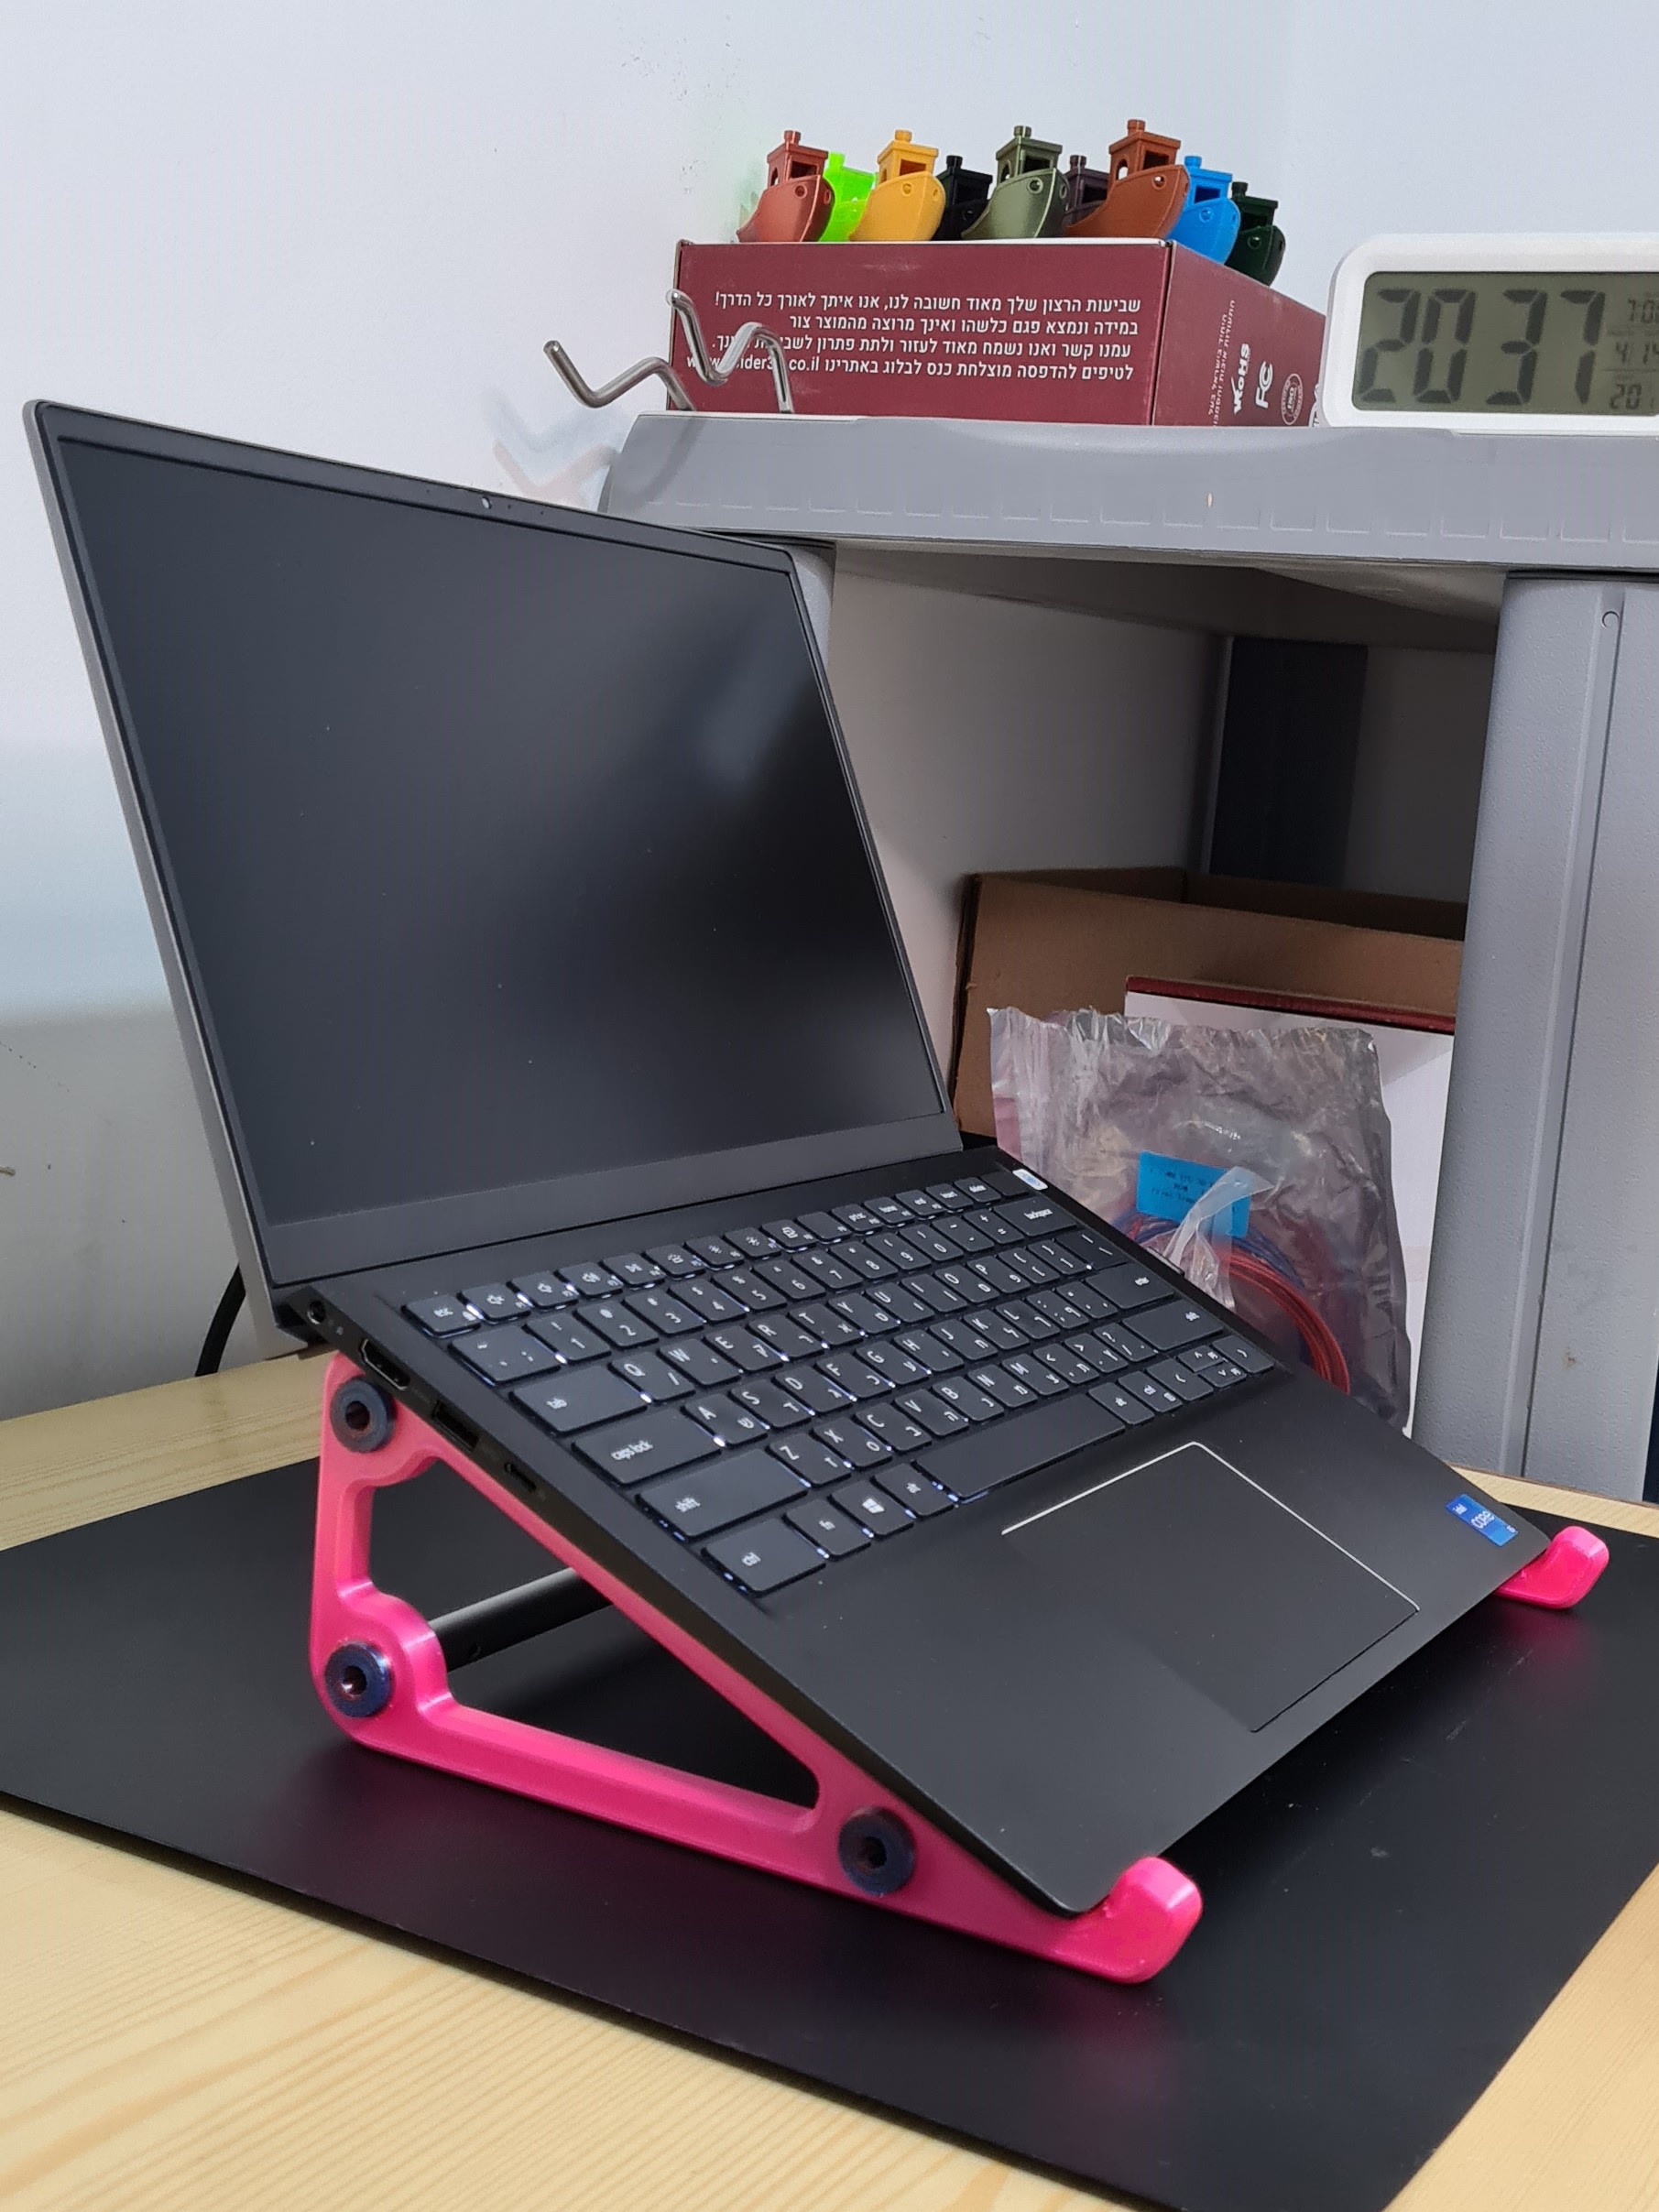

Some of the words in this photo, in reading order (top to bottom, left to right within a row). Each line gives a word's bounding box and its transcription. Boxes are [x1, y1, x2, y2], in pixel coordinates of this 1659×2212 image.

[715, 290, 752, 310] הדרך!
[756, 290, 772, 307] כל
[778, 291, 816, 311] לאורך
[821, 294, 854, 311] איתך
[858, 295, 880, 309] אנו
[884, 294, 910, 311] לנו,
[913, 296, 961, 311] חשובה
[966, 298, 1002, 311] מאוד
[1007, 295, 1038, 315] שלך
[1086, 299, 1141, 312] שביעות
[1042, 299, 1082, 316] הרצון
[790, 315, 812, 329] צור
[815, 315, 868, 331] מהמוצר
[871, 317, 915, 331] מרוצה
[920, 318, 956, 335] ואינך
[961, 316, 1007, 333] כלשהו
[1012, 320, 1041, 334] פגם
[1045, 321, 1089, 334] ונמצא
[1093, 321, 1139, 335] במידה
[816, 336, 856, 354] פתרון
[858, 335, 894, 353] ולתת
[900, 337, 938, 354] לעזור
[942, 340, 977, 354] מאוד
[982, 341, 1023, 356] נשמח
[1028, 342, 1056, 357] ואנו
[1098, 343, 1131, 358] עמנו
[1061, 343, 1094, 361] קשר
[824, 358, 879, 374] באתרינו
[882, 357, 922, 375] לבלוג
[926, 362, 953, 376] כנס
[955, 360, 1012, 378] מוצלחת
[1017, 363, 1077, 379] להדפסה
[1081, 364, 1134, 381] לטיפים
[1255, 361, 1274, 409] FC
[933, 1242, 947, 1253] 0
[900, 1250, 914, 1262] 9
[865, 1259, 880, 1270] 8
[975, 1263, 988, 1275] P
[829, 1269, 843, 1280] 7
[944, 1272, 960, 1284] O
[791, 1279, 806, 1291] 6
[751, 1289, 767, 1301] 5
[874, 1291, 891, 1303] U
[712, 1301, 726, 1311] 4
[836, 1301, 854, 1313] Y
[665, 1312, 682, 1324] 3
[799, 1312, 815, 1324] T
[1003, 1309, 1020, 1321] L
[619, 1324, 637, 1337] 2
[757, 1324, 777, 1337] R
[971, 1318, 989, 1330] K
[940, 1327, 955, 1341] J
[570, 1337, 586, 1349] 1
[715, 1335, 734, 1350] E
[901, 1338, 921, 1352] H
[668, 1347, 691, 1363] W
[867, 1350, 886, 1364] G
[623, 1363, 646, 1377] Q
[825, 1363, 841, 1377] F
[1010, 1362, 1030, 1376] M
[784, 1377, 803, 1390] D
[977, 1374, 996, 1387] N
[741, 1390, 760, 1405] S
[941, 1387, 959, 1400] B
[697, 1405, 717, 1421] A
[904, 1400, 922, 1413] V
[867, 1413, 885, 1429] C
[824, 1429, 845, 1444] X
[780, 1445, 800, 1461] Z
